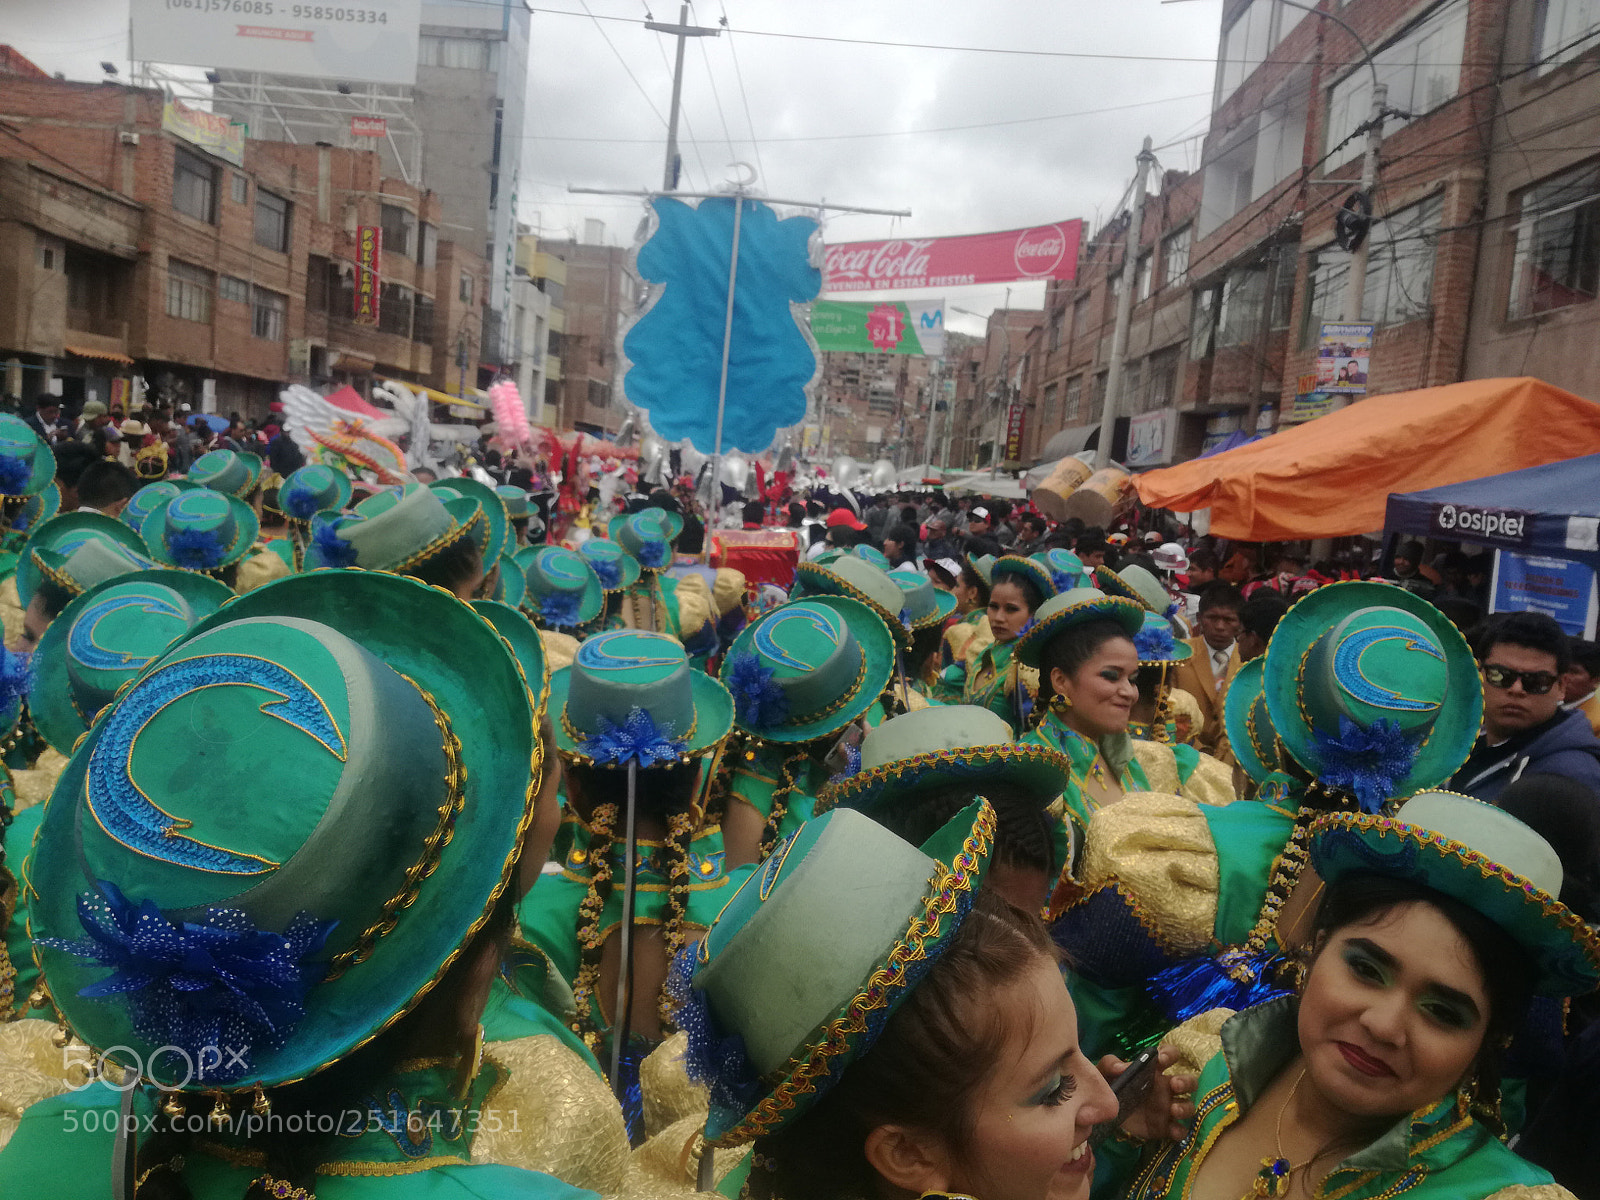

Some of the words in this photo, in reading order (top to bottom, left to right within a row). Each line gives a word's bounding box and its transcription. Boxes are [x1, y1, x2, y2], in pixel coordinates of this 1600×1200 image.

[292, 4, 388, 25] 958505334
[361, 229, 374, 315] POLLERIA
[826, 281, 872, 292] NVENIDA
[874, 279, 890, 290] EN
[892, 276, 927, 289] ESTAS
[928, 273, 976, 287] FIESTAS
[1458, 510, 1525, 538] osiptel
